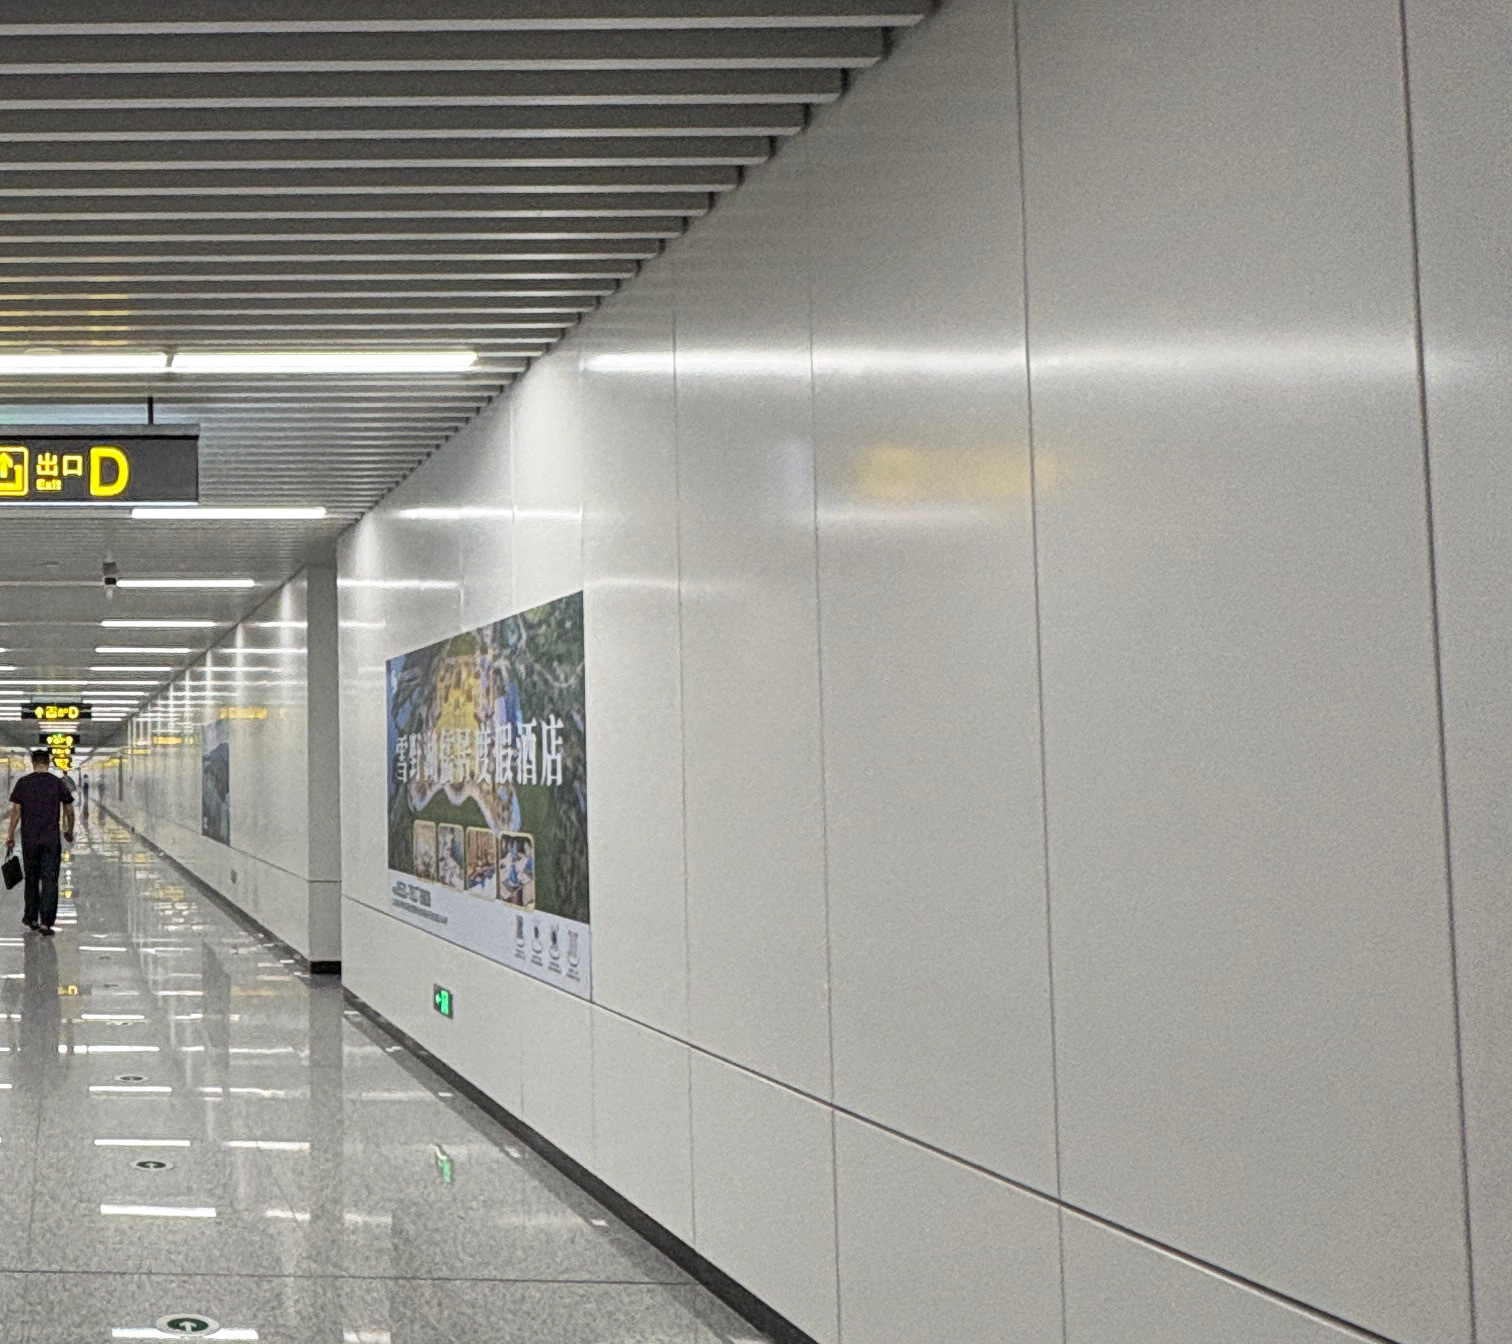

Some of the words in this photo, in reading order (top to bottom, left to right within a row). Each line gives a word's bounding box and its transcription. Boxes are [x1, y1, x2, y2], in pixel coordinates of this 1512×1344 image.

[36, 452, 83, 477] 出口
[89, 446, 130, 497] D
[36, 478, 62, 491] Exit
